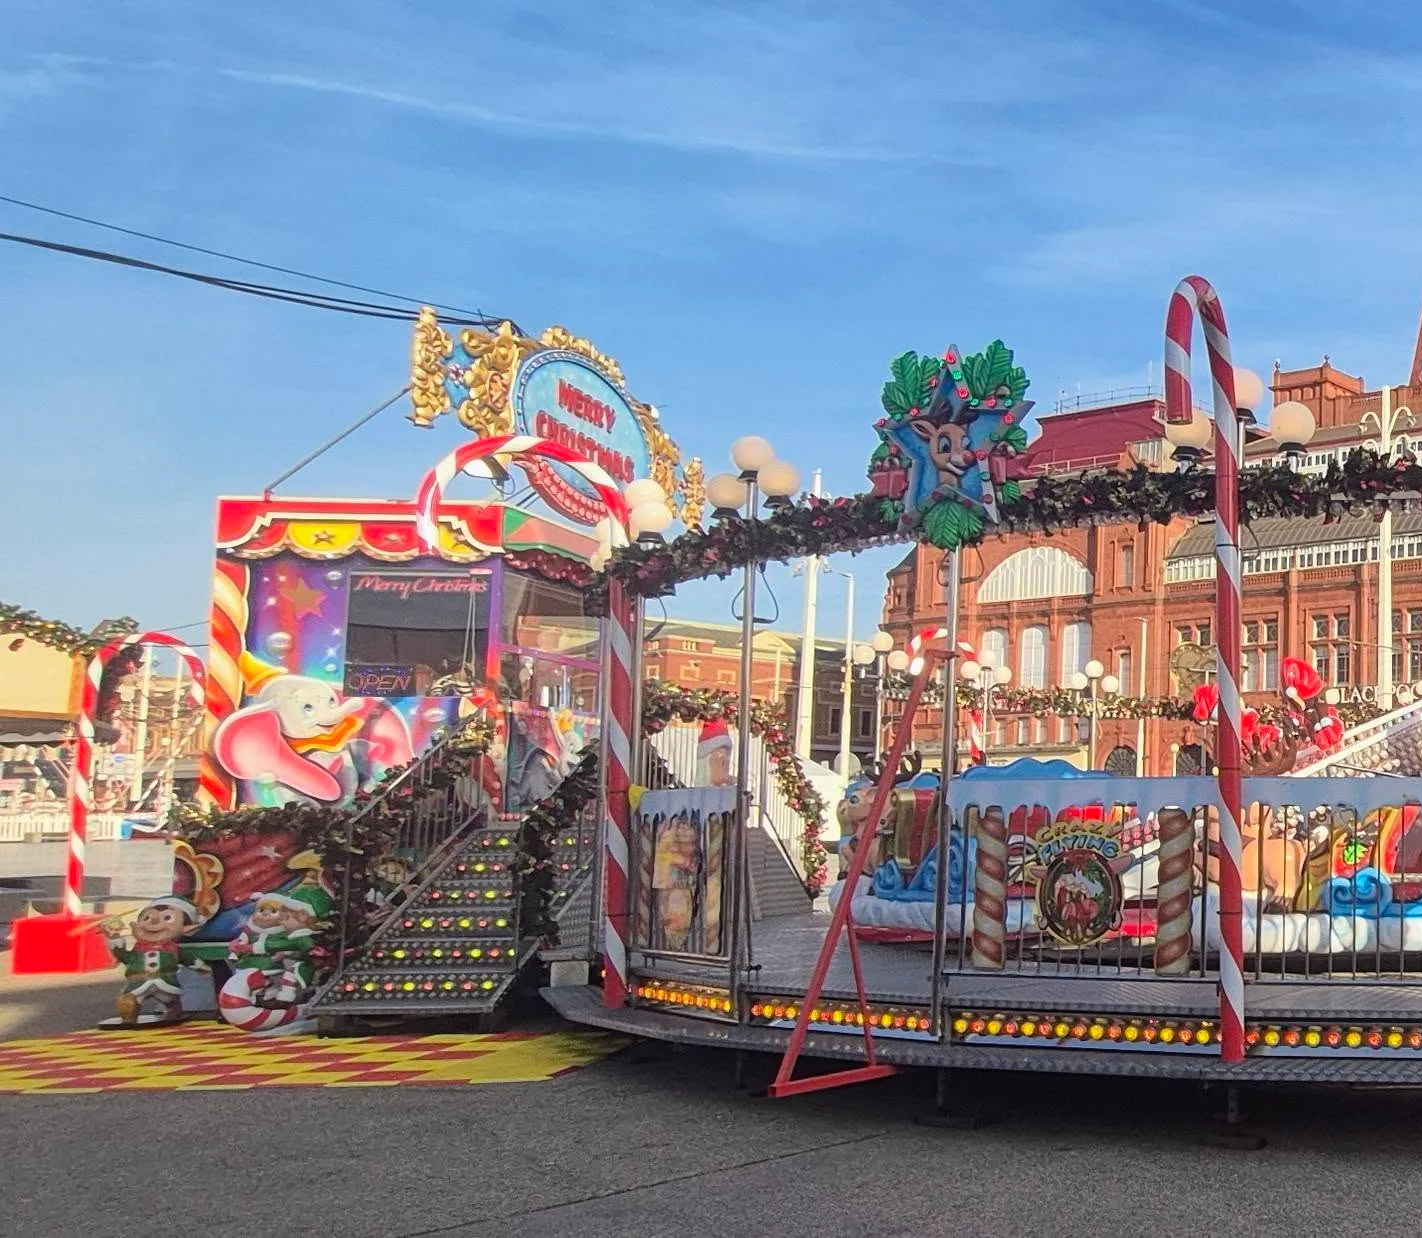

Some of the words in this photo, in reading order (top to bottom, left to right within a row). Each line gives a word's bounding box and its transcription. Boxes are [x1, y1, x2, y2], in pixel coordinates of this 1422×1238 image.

[556, 378, 616, 434] MERRY
[534, 410, 635, 484] CHRISTMAS
[353, 576, 411, 599] Merry
[412, 577, 488, 592] Christmas
[348, 673, 412, 690] OPEN
[1042, 834, 1119, 866] FLYING
